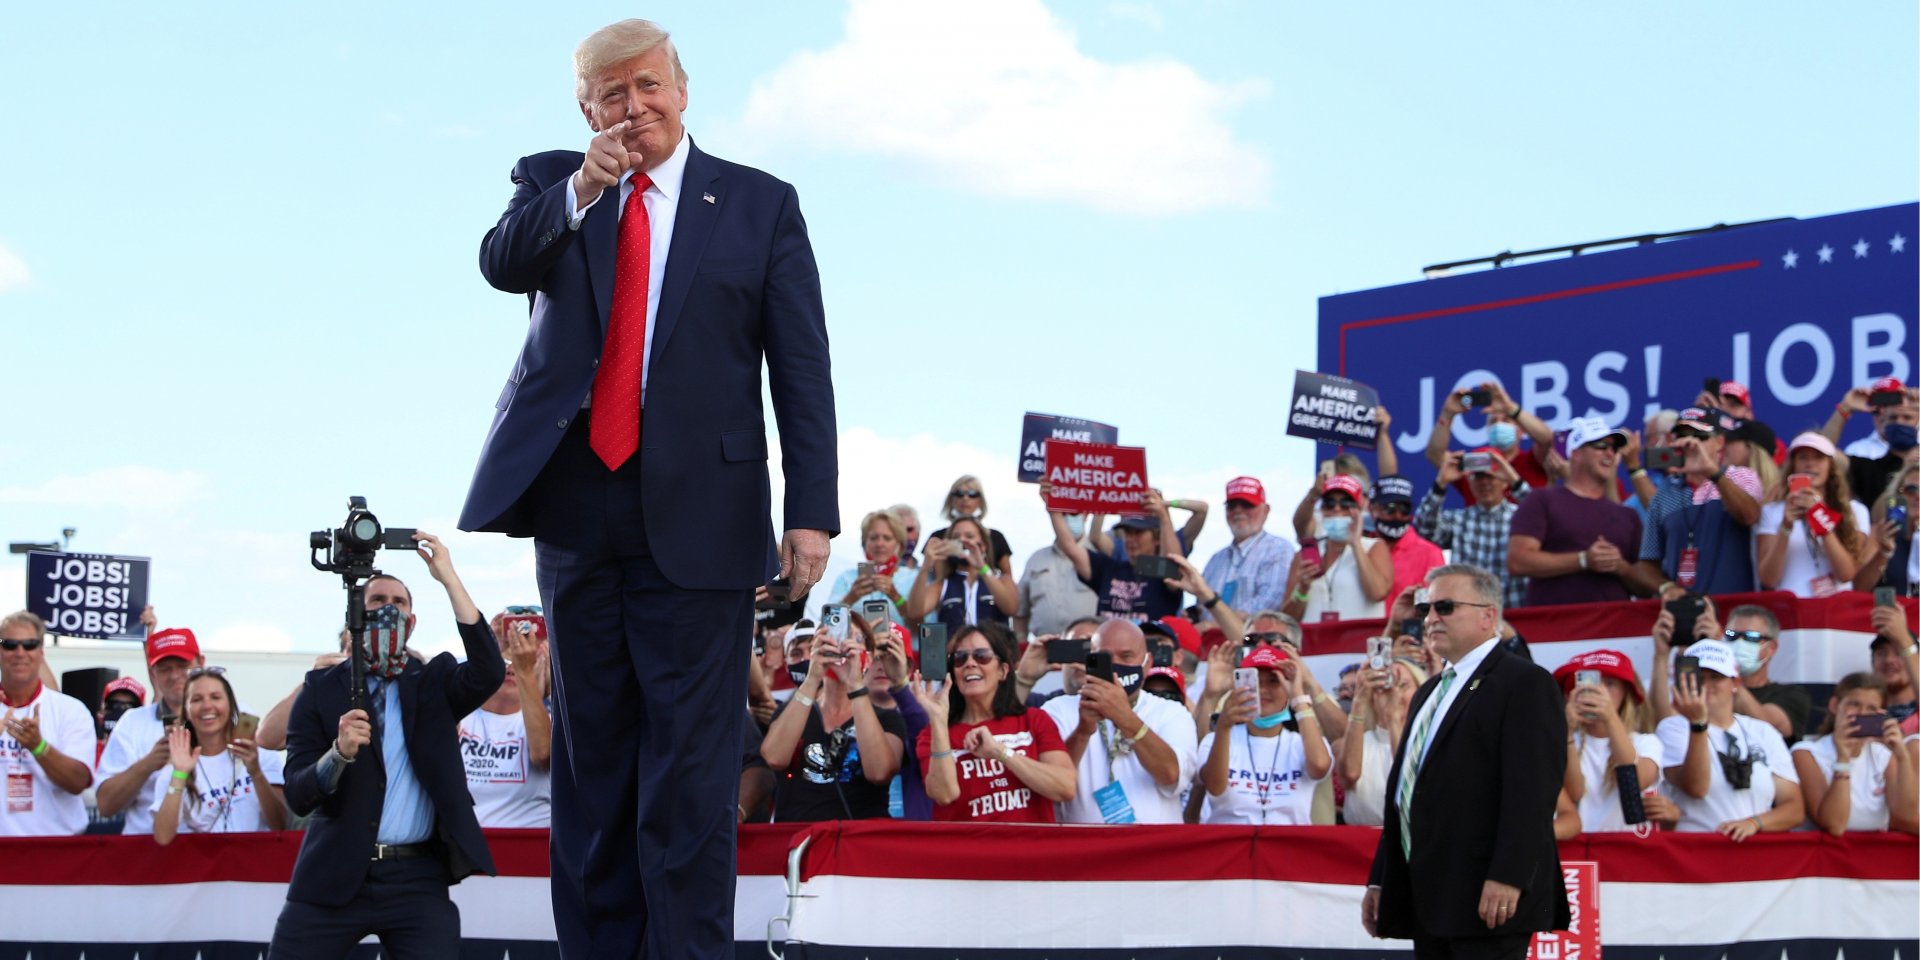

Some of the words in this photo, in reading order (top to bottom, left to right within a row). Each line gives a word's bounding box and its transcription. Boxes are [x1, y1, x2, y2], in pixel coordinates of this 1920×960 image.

[1321, 384, 1358, 402] MAKE
[1397, 344, 1662, 454] JOBS!
[1294, 394, 1377, 424] AMERICA
[1051, 428, 1091, 443] MAKE
[1292, 412, 1335, 431] GREAT
[1335, 421, 1377, 439] AGAIN
[1074, 452, 1114, 469] MAKE
[1049, 466, 1143, 488] AMERICA
[1050, 485, 1095, 501] GREAT
[1098, 490, 1145, 503] AGAIN
[47, 558, 130, 584] JOBS!
[45, 583, 129, 609] JOBS!
[44, 608, 127, 634] JOBS!
[1229, 768, 1303, 782] TRUMP
[968, 788, 1031, 817] TRUMP
[1563, 868, 1580, 935] AGAIN
